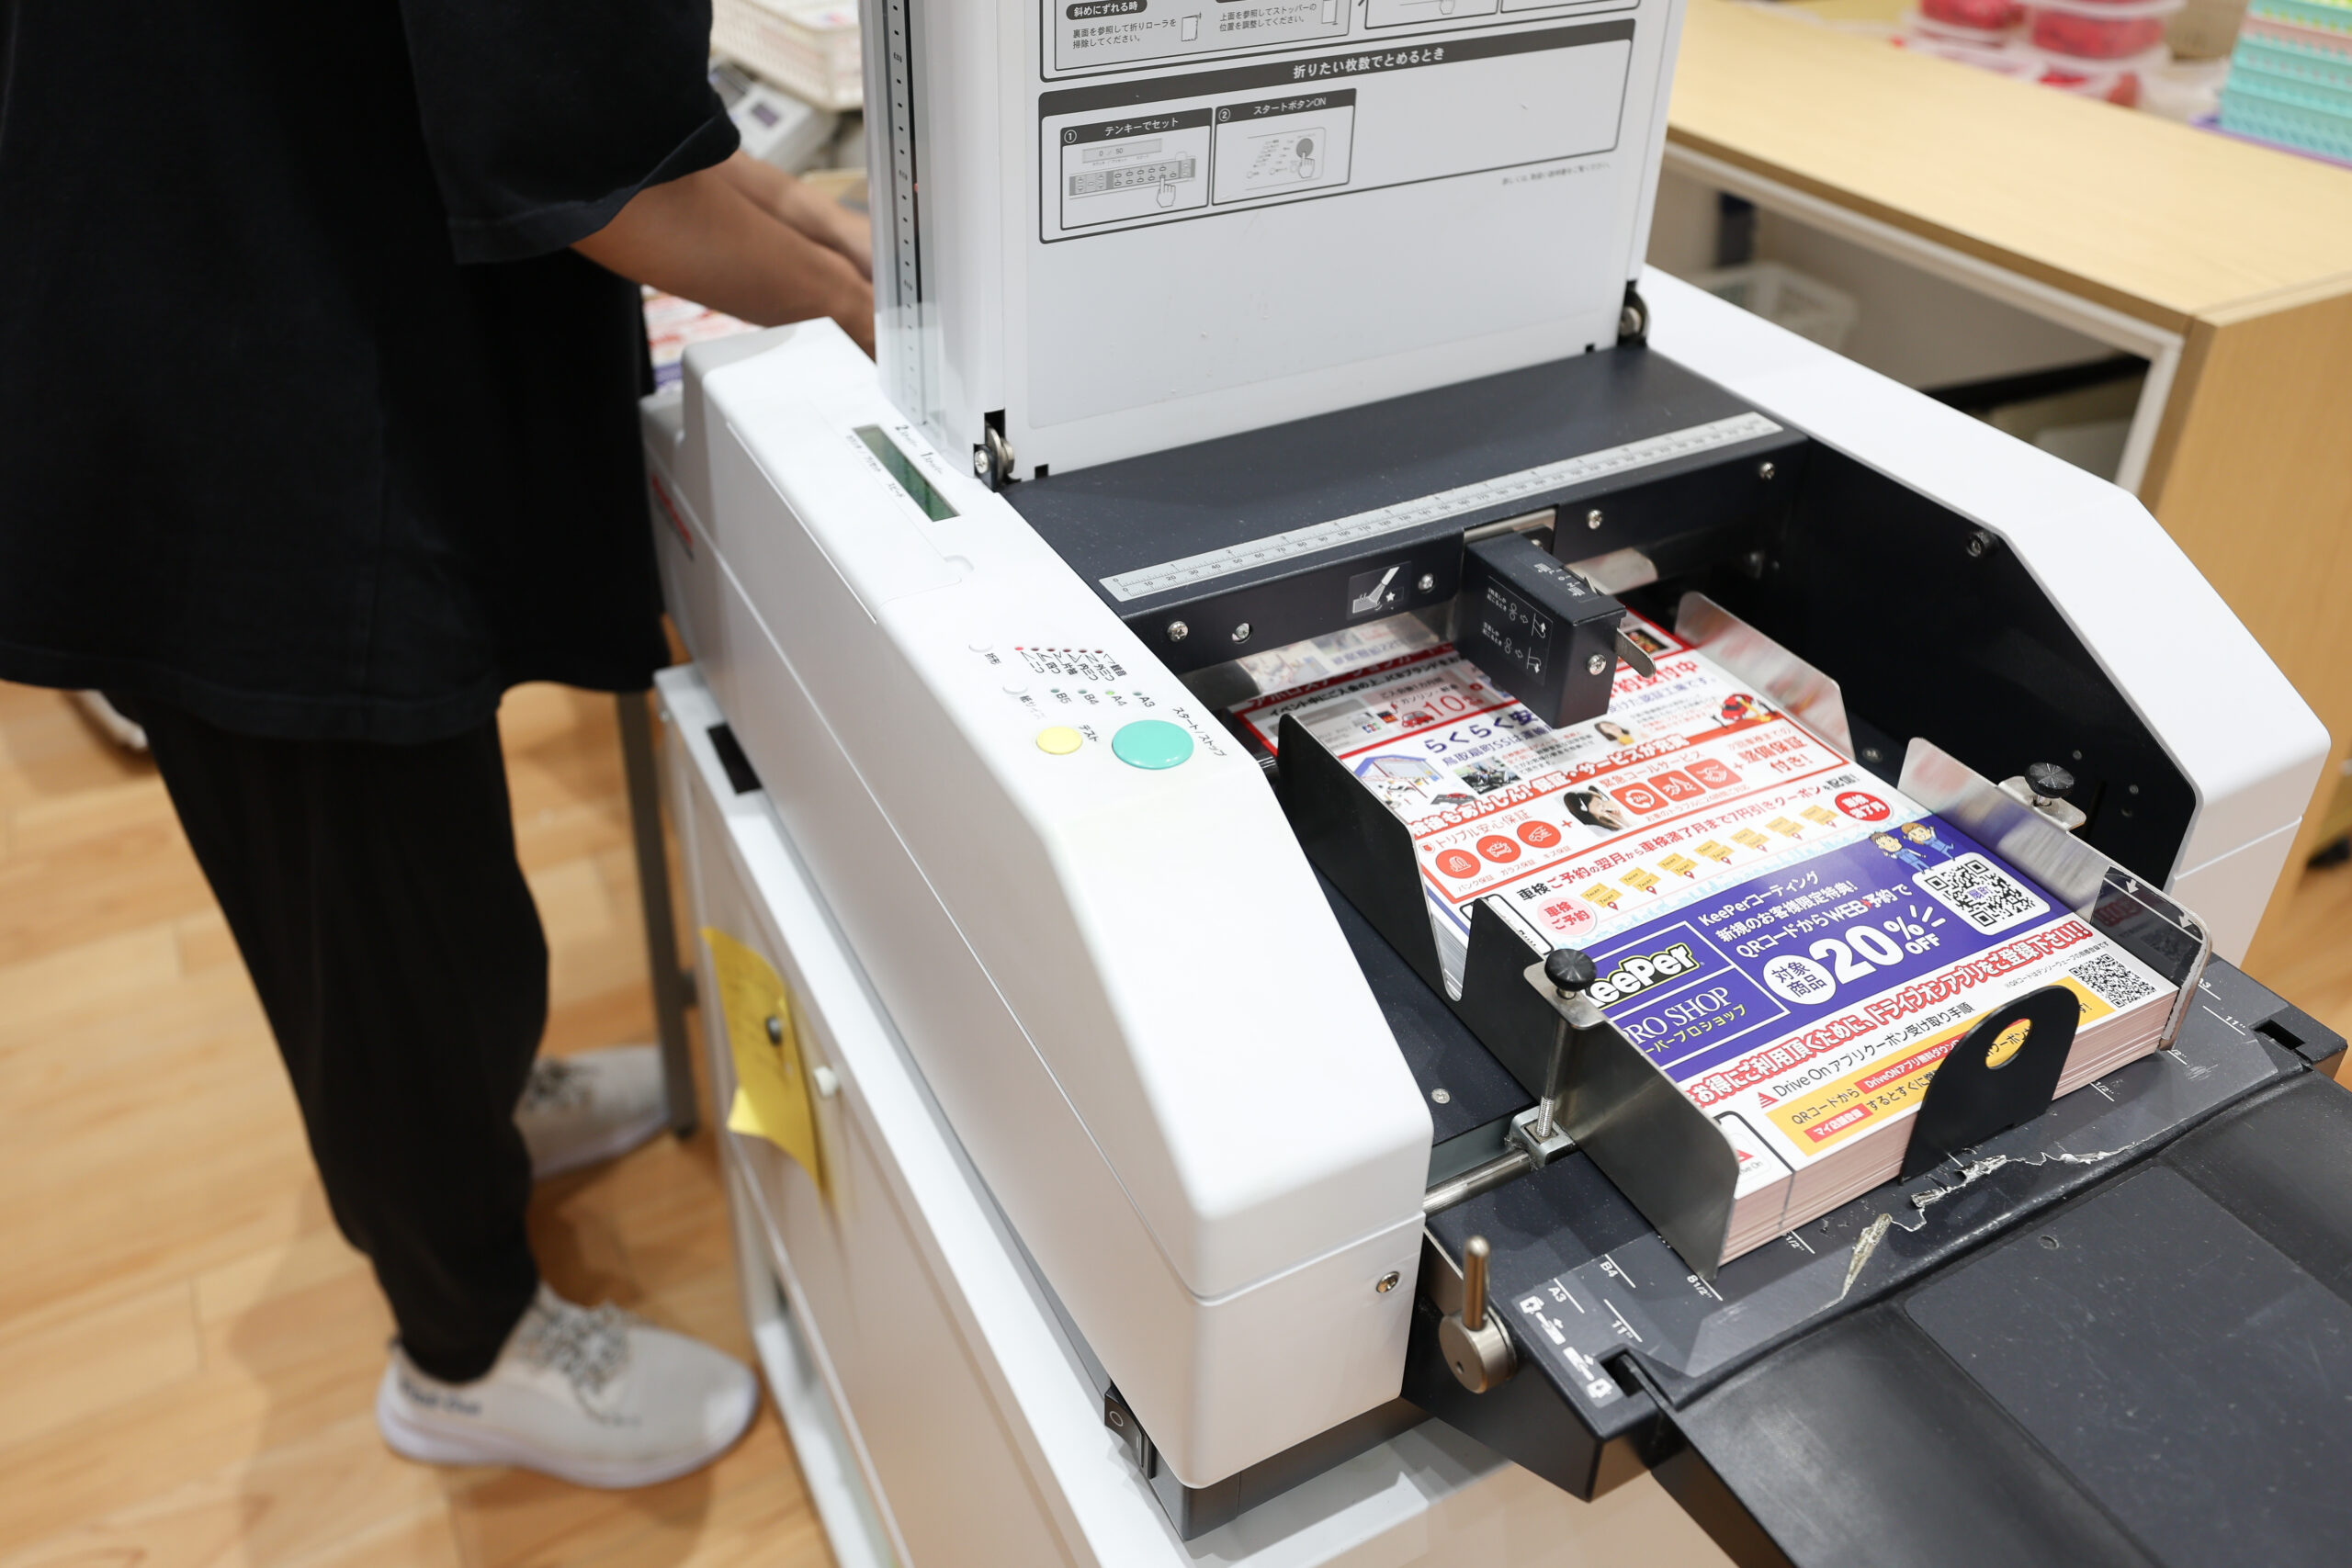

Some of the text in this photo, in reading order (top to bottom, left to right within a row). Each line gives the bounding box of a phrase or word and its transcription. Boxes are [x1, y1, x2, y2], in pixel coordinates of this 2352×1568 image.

[1073, 2, 1138, 17] 斜めにずれる時
[1219, 3, 1317, 22] 上面を参照してストッパーの
[1072, 18, 1177, 39] 裏面を参照して折りローラを
[1219, 17, 1306, 32] 位置を調整してください。
[1072, 35, 1141, 50] 掃除してください。
[1293, 47, 1445, 79] 折りたい枚数でとめるとき
[1253, 97, 1327, 116] スタートボタンON
[1104, 118, 1179, 136] テンキーでセット
[1610, 660, 1699, 698] 約受付中
[1140, 695, 1155, 707] A3
[1079, 724, 1100, 743] テスト
[1435, 808, 1533, 849] トリプル安心保証
[1544, 900, 1575, 917] 車検
[1698, 870, 1819, 926] KeePerコーティング
[1552, 909, 1591, 931] ご予約
[1715, 880, 1859, 942] 新規のお客様限定特典!
[1905, 933, 1940, 955] OFF
[1771, 961, 1811, 984] 対象
[1787, 976, 1828, 998] 商品
[1664, 987, 1733, 1027] SHOP
[1689, 920, 2091, 1103] お得にご利用頂くために、ドライブオンアプリをご登録下さい!!
[1773, 1075, 1811, 1098] Drive
[1808, 1066, 1832, 1081] On
[1791, 1088, 1860, 1125] QRコードから
[1600, 1261, 1618, 1278] B4
[1548, 1286, 1567, 1303] A3
